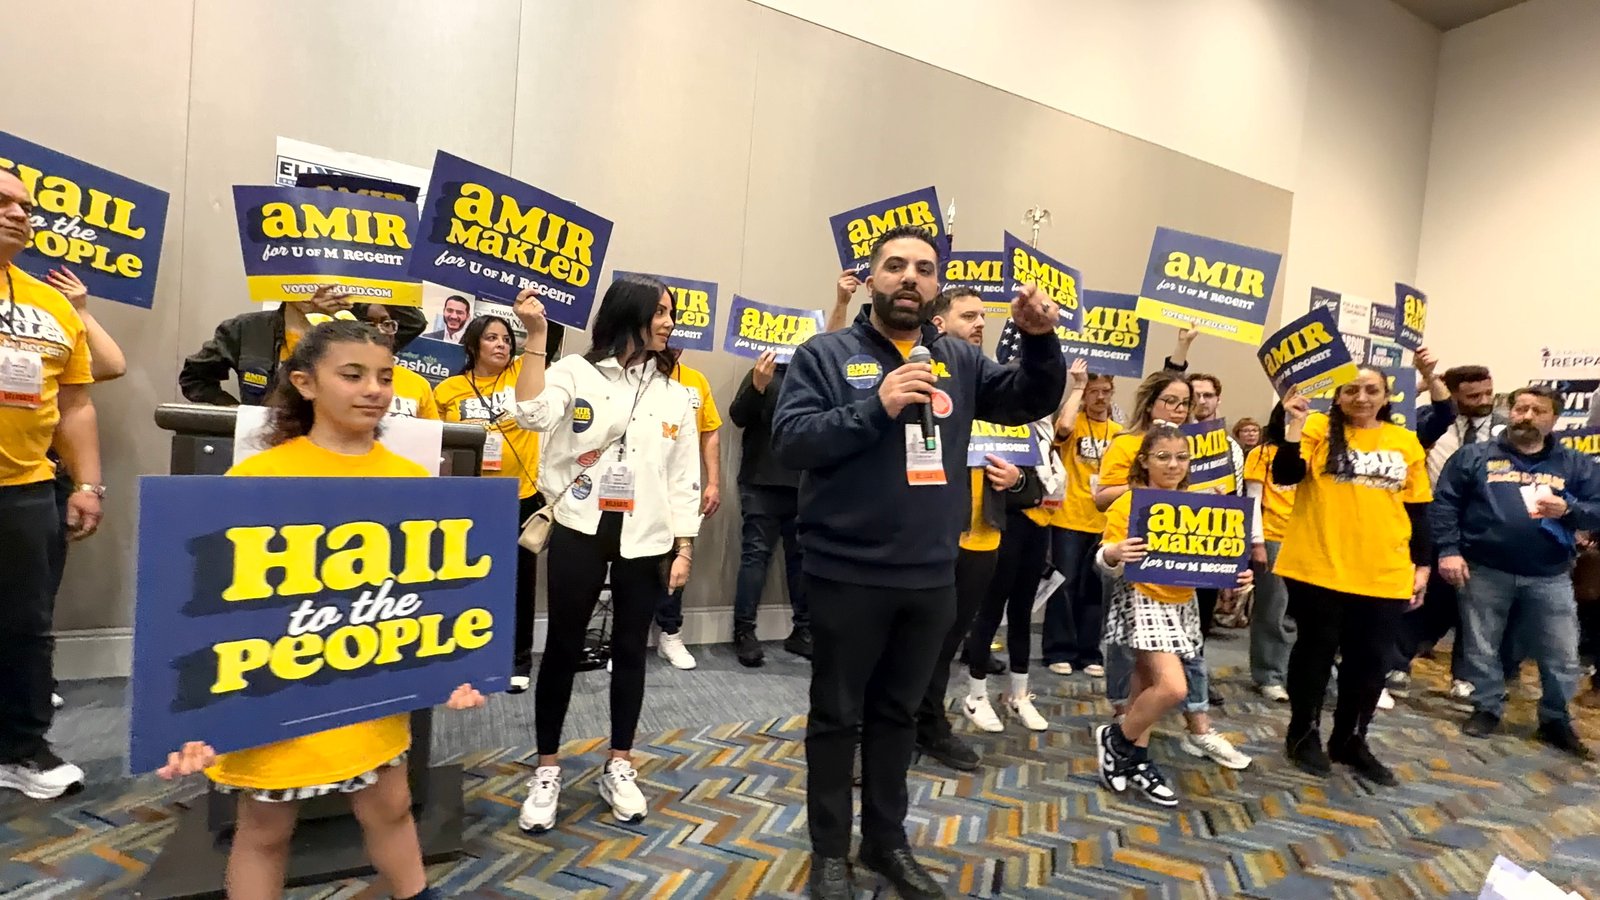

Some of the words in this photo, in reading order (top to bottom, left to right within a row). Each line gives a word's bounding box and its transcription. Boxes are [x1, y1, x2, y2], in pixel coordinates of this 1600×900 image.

[52, 216, 98, 241] the
[261, 202, 412, 249] aMIR
[453, 183, 594, 266] aMIR
[847, 201, 936, 244] aMIR
[25, 228, 143, 278] OPLe
[262, 244, 289, 261] for
[292, 246, 303, 258] U
[306, 248, 321, 257] OF
[324, 249, 338, 259] M
[446, 217, 590, 288] MaKLeD
[434, 250, 467, 267] for
[469, 261, 483, 274] U
[483, 267, 498, 279] OF
[500, 271, 516, 286] M
[946, 260, 1004, 282] aMI
[1014, 248, 1077, 298] aMIR
[1164, 251, 1265, 298] aMIR
[668, 286, 710, 314] IR
[1156, 279, 1176, 291] for
[1178, 285, 1187, 294] U
[1197, 290, 1208, 300] M
[491, 308, 514, 318] SYLVIA
[741, 307, 817, 332] aMIR
[1083, 306, 1140, 333] MIR
[751, 342, 758, 350] U
[1061, 345, 1069, 353] U
[661, 421, 679, 441] M
[1186, 428, 1229, 460] MIR
[1147, 502, 1246, 538] aMIR
[1146, 531, 1246, 557] MaKLeD
[221, 519, 493, 602] HaIL
[1140, 556, 1163, 570] for
[1165, 560, 1175, 569] U
[1187, 562, 1198, 572] M
[288, 600, 341, 636] to
[349, 579, 423, 625] the
[209, 607, 494, 694] PeOPLe
